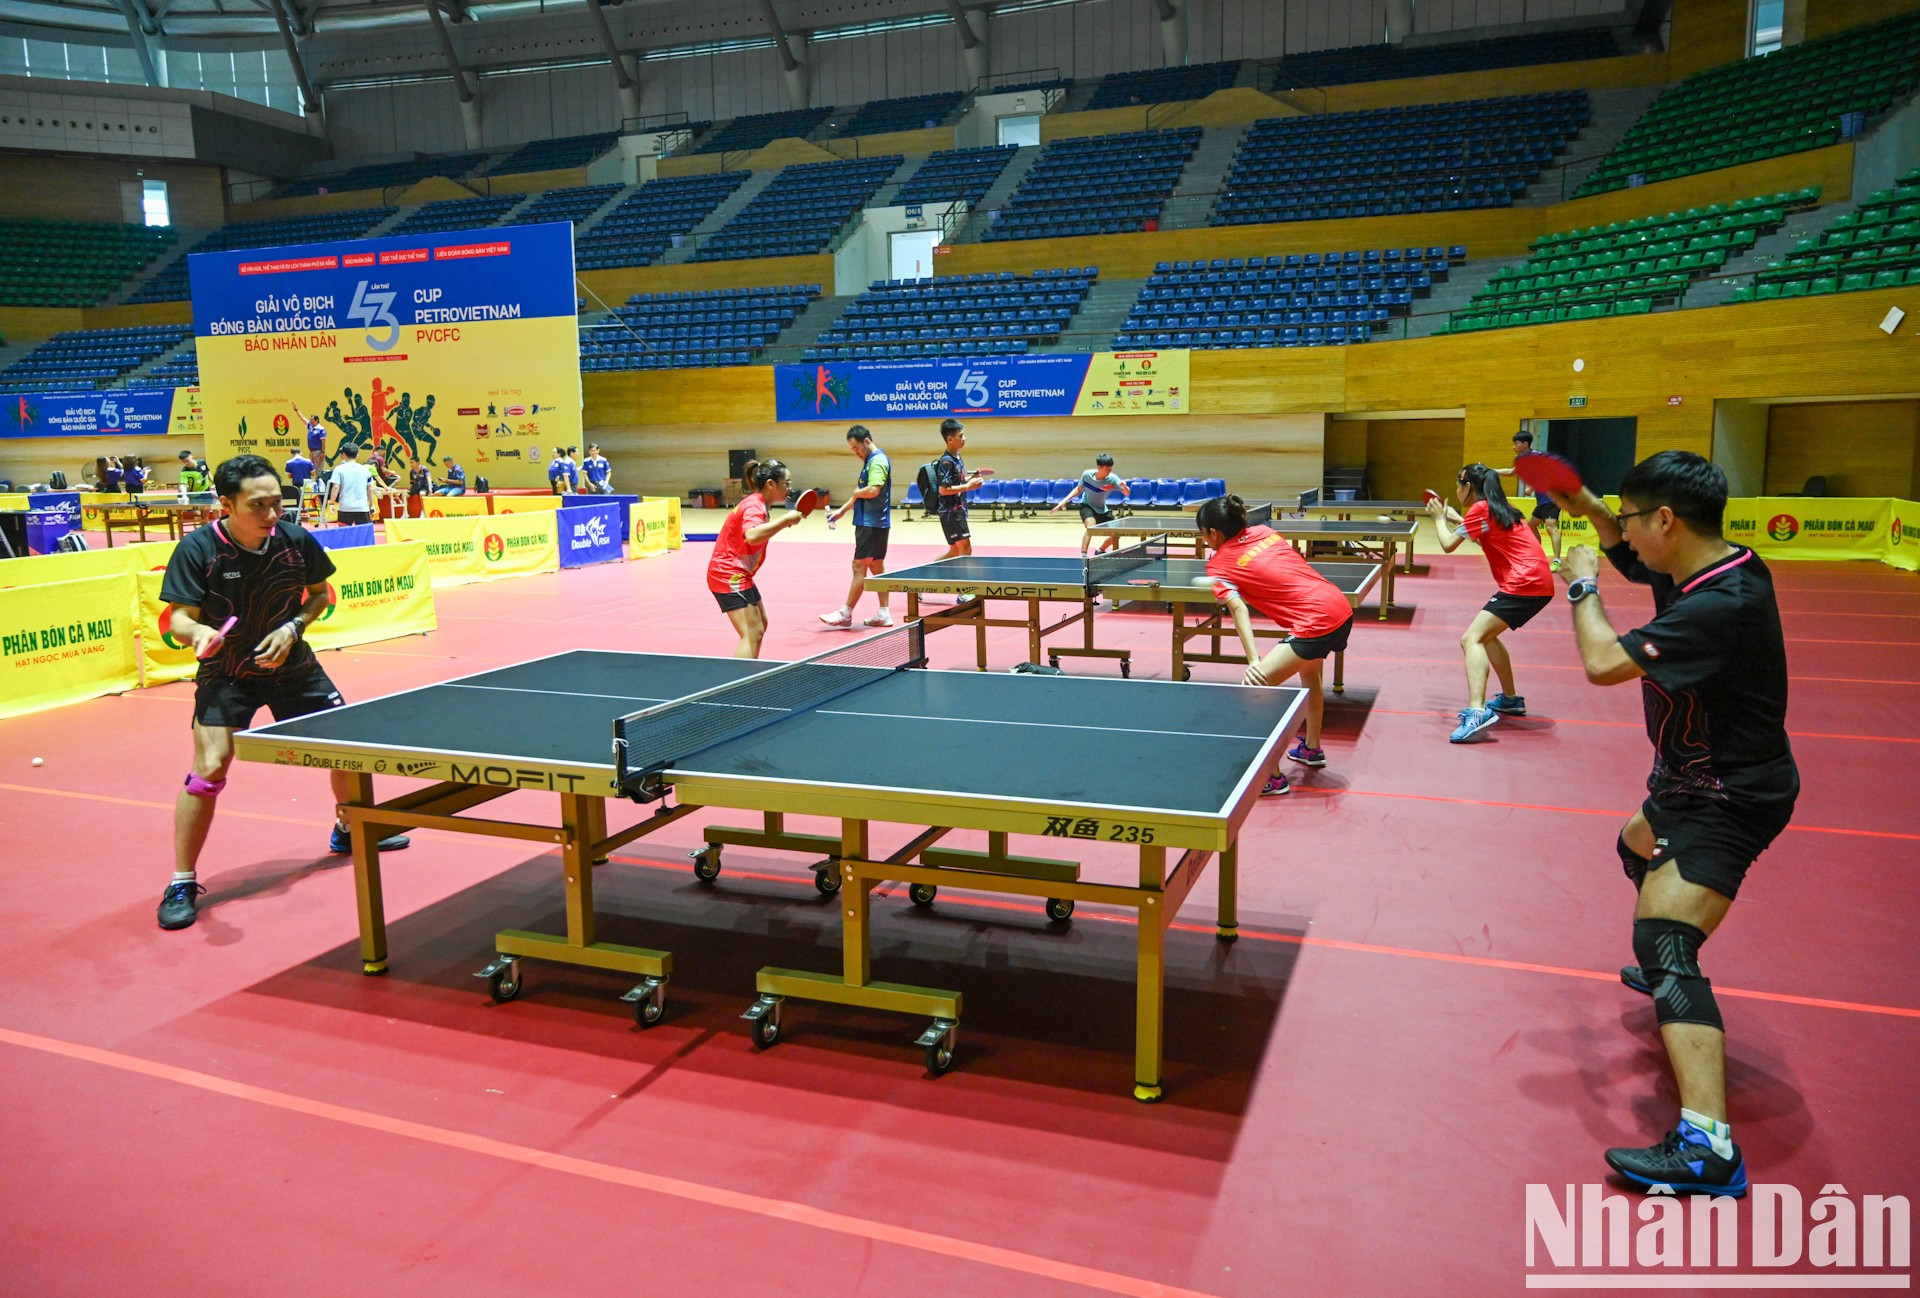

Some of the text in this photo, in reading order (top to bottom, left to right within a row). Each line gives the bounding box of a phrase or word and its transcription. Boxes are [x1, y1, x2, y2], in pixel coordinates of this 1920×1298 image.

[414, 288, 442, 304] CUP
[255, 294, 334, 314] GIẢI VÔ ĐỊCH
[415, 304, 521, 324] PETROVIETNAM
[210, 310, 336, 335] BÓNG BÀN QUỐC GIA
[245, 331, 336, 352] BÁO NHÂN DÂN
[416, 328, 460, 343] PVCFC
[896, 380, 947, 392] GIẢI VÔ ĐỊCH
[998, 380, 1017, 388] CUP
[865, 390, 947, 402] BÓNG BÀN QUỐC GIA
[998, 389, 1064, 398] PETROVIETNAM
[886, 400, 947, 411] BÁO NHÂN DÂN
[998, 400, 1027, 409] PVCFC
[496, 449, 521, 457] Vinamilk
[1573, 520, 1587, 530] MAU
[1730, 518, 1750, 531] PHÂN
[1804, 518, 1875, 531] PHÂN BÓN CÀ MAU
[571, 538, 591, 550] Double
[341, 575, 414, 600] PHÂN BÓN CÀ MAU
[986, 586, 1058, 597] MOFIT
[348, 603, 360, 611] HẠT
[360, 600, 378, 609] NGỌC
[2, 618, 113, 656] PHÂN BÓN CÀ MAU
[15, 659, 31, 669] HẠT
[33, 653, 60, 665] NGỌC
[81, 643, 105, 655] VÀNG
[303, 753, 363, 771] DOUBLE FISH
[451, 763, 585, 792] MOFIT
[1042, 816, 1100, 840] 双鱼
[1109, 824, 1155, 844] 235
